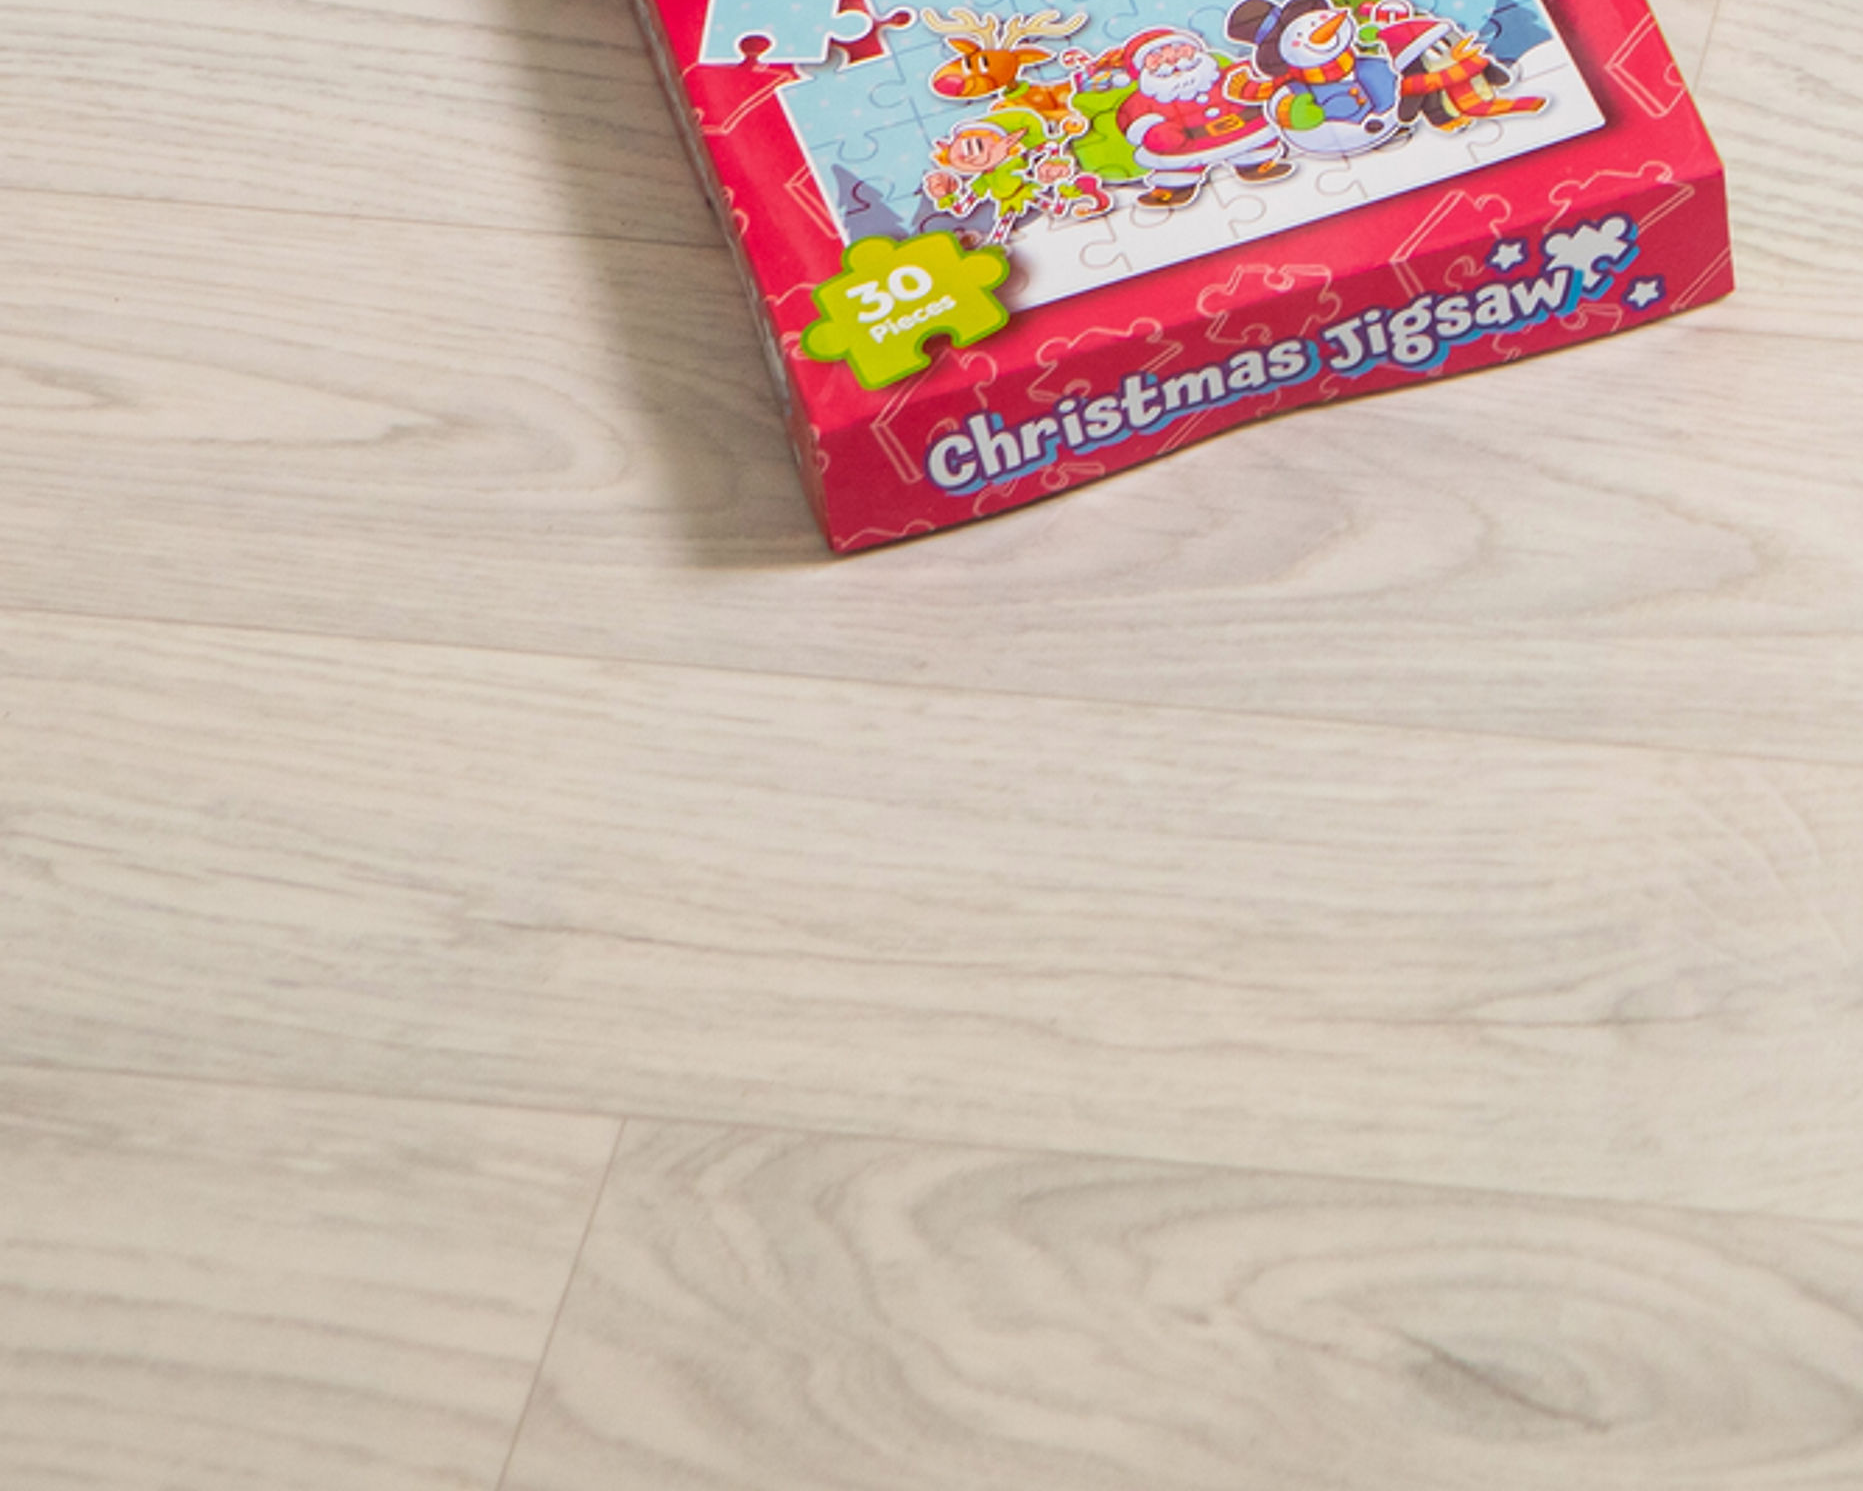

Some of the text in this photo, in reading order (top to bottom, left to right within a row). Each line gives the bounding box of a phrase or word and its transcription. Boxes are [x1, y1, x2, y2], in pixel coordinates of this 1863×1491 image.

[846, 264, 934, 325] 30
[869, 294, 957, 345] Pieces
[925, 269, 1571, 491] Christmas Jigsaw
